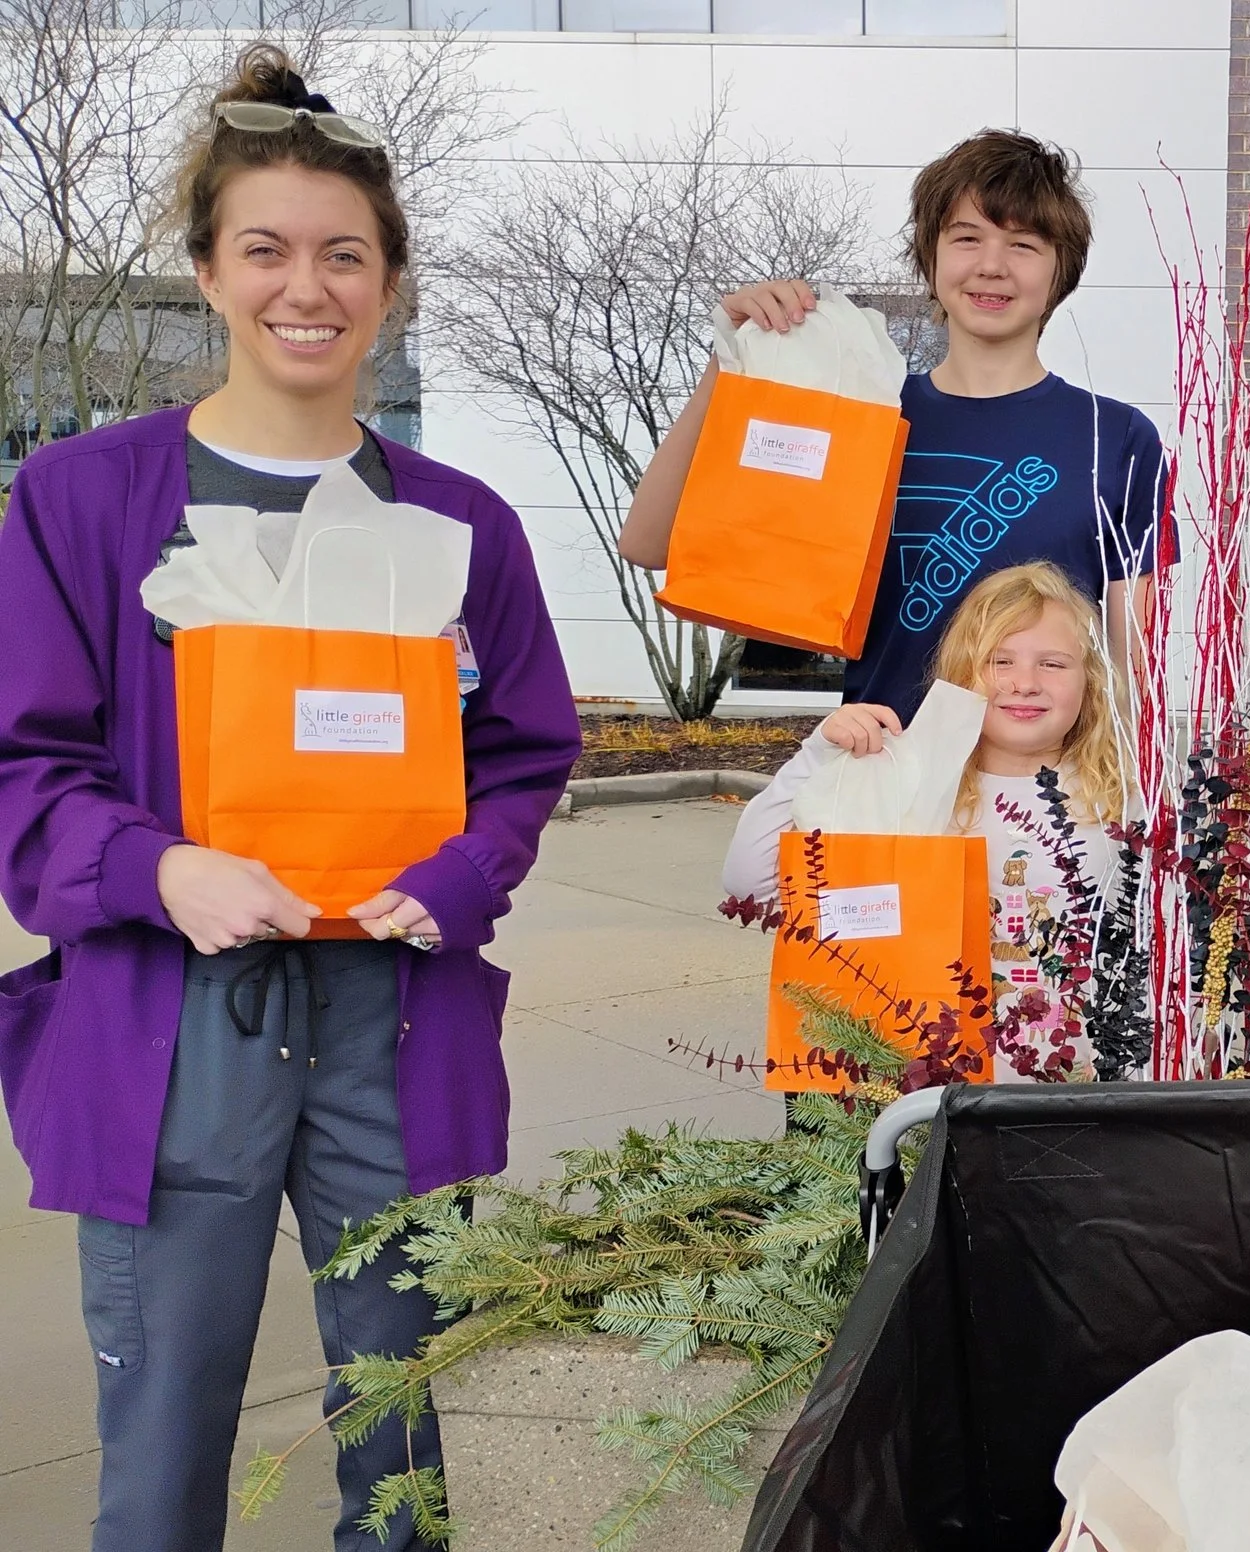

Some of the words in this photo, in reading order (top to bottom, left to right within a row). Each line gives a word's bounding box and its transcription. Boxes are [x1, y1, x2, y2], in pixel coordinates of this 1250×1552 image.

[760, 435, 785, 450] little
[787, 440, 825, 457] giraffe
[899, 456, 1058, 632] adidas
[316, 708, 349, 722] little
[353, 710, 401, 726] giraffe
[323, 726, 378, 735] foundation
[834, 903, 858, 916] little
[860, 899, 897, 916] giraffe
